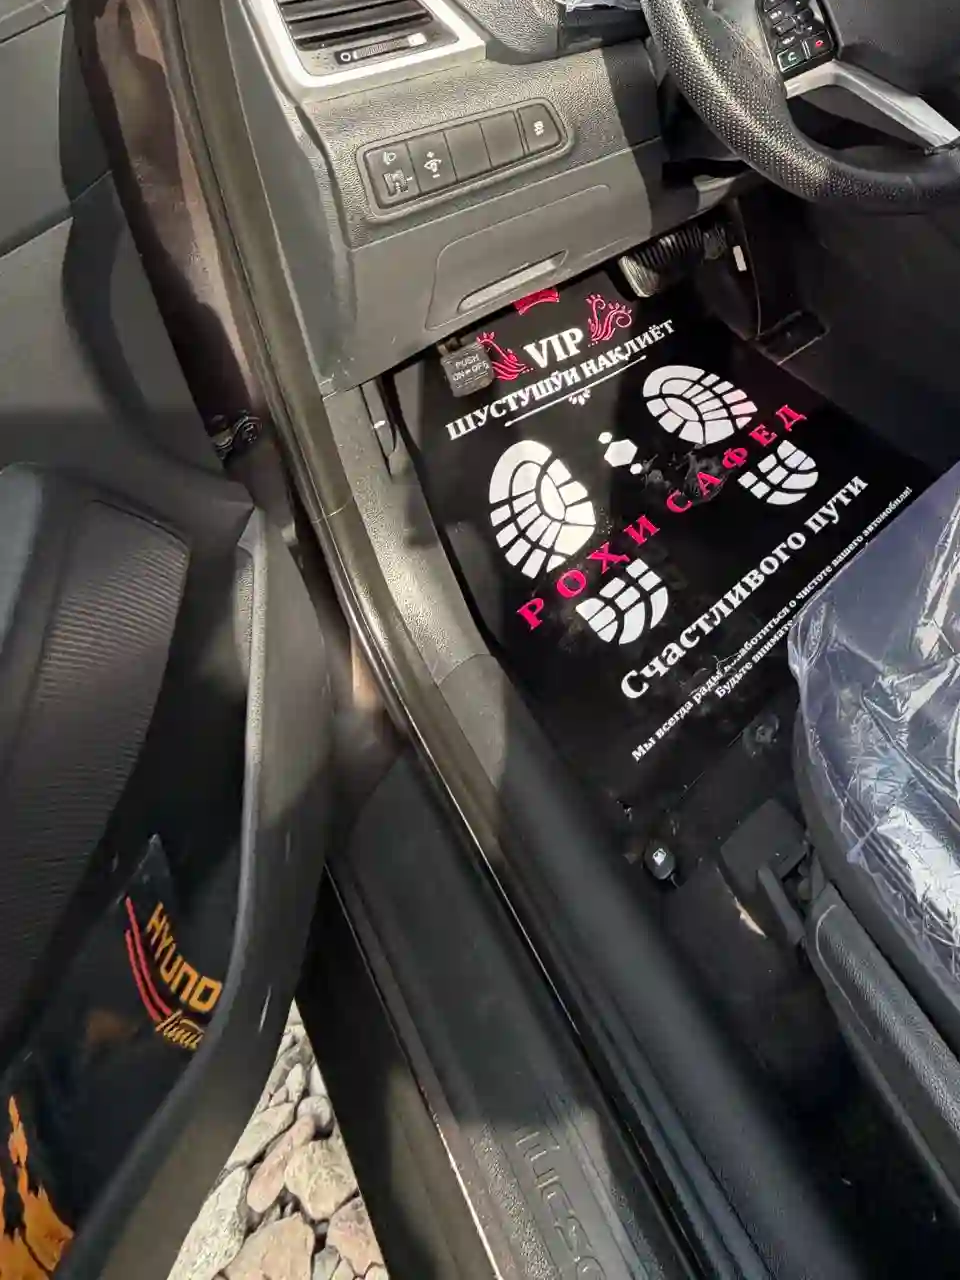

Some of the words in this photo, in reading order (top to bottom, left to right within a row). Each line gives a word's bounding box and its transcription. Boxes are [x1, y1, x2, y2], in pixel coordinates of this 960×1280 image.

[523, 327, 584, 369] VIP
[666, 404, 807, 513] САФЕД
[621, 531, 806, 699] Счастливого
[804, 476, 868, 534] пути
[632, 736, 656, 762] Мы
[655, 700, 694, 740] всегда
[692, 669, 724, 705] рады
[788, 599, 797, 608] о
[795, 565, 833, 600] чистоте
[831, 535, 864, 568] вашего
[715, 661, 753, 699] Будьте
[752, 619, 794, 663] внимате
